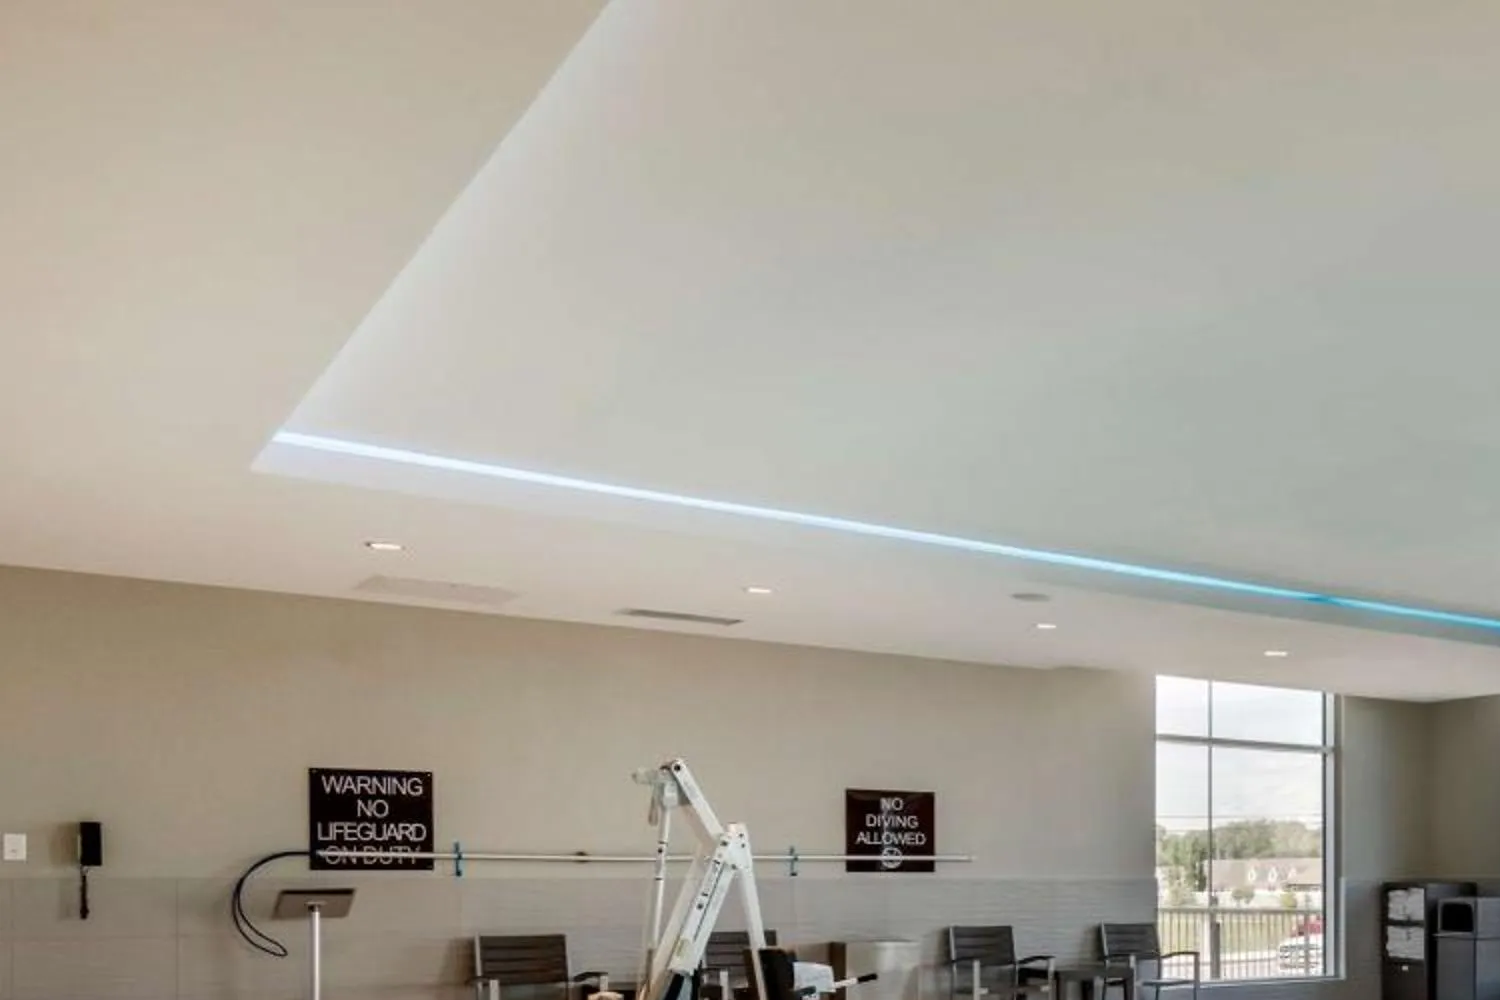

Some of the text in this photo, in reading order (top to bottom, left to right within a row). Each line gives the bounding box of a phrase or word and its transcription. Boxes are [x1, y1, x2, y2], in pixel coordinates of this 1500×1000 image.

[321, 775, 424, 796] WARNING
[357, 799, 389, 818] NO
[881, 797, 904, 811] NO
[865, 813, 920, 829] DIVING
[317, 822, 427, 842] LIFEGUARD
[855, 830, 927, 846] ALLOWED
[323, 845, 358, 865] ON
